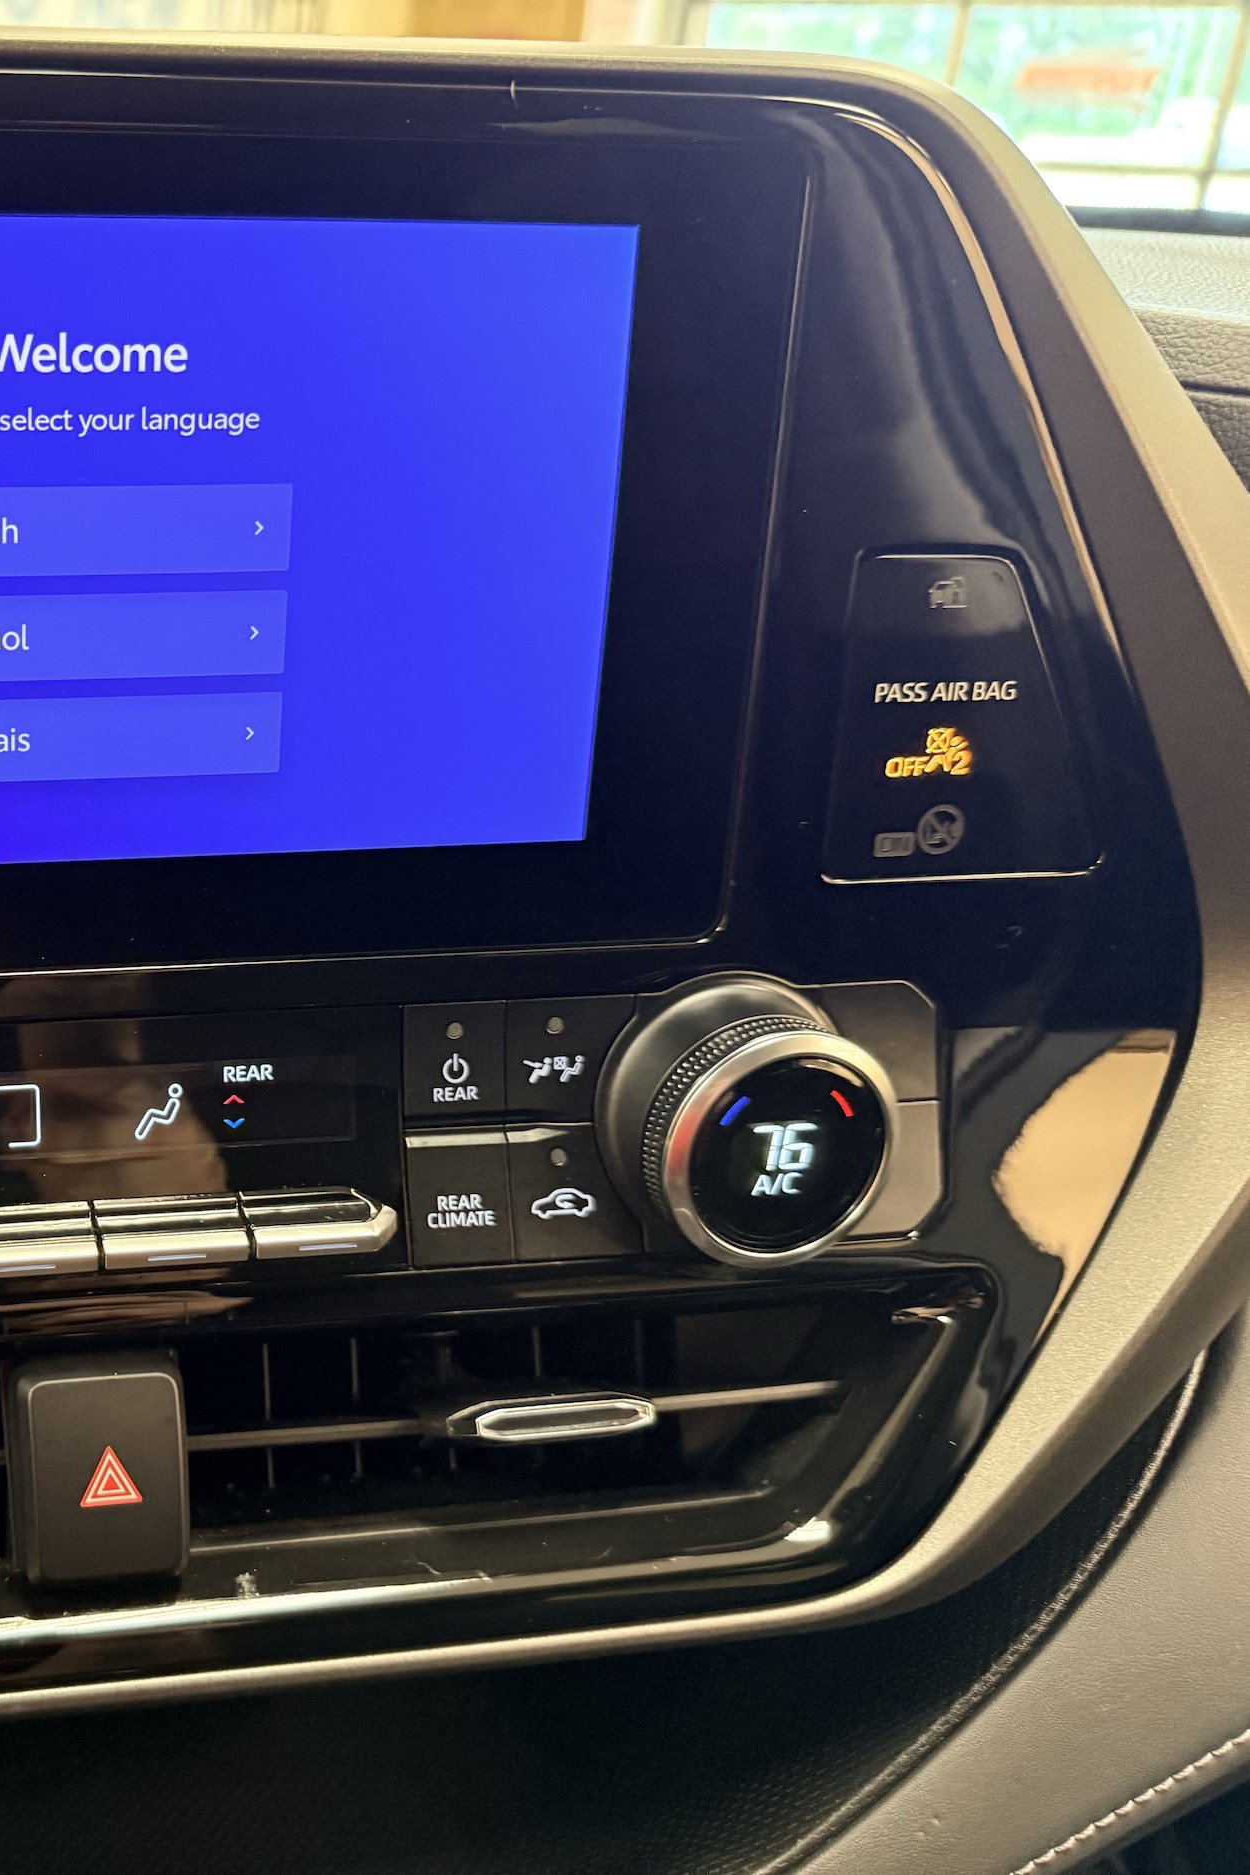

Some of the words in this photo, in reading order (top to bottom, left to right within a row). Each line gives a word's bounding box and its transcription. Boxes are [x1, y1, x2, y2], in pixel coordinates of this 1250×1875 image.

[0, 408, 73, 431] select
[78, 409, 135, 437] your
[141, 406, 261, 436] language
[874, 682, 929, 703] PASS
[930, 682, 970, 702] AIR
[972, 680, 1018, 701] BAG
[884, 756, 928, 778] OFF
[222, 1063, 275, 1083] REAR
[432, 1085, 479, 1103] REAR
[752, 1121, 819, 1171] 76
[750, 1171, 803, 1197] A/C
[436, 1193, 482, 1210] REAR
[427, 1208, 497, 1229] CLIMATE
